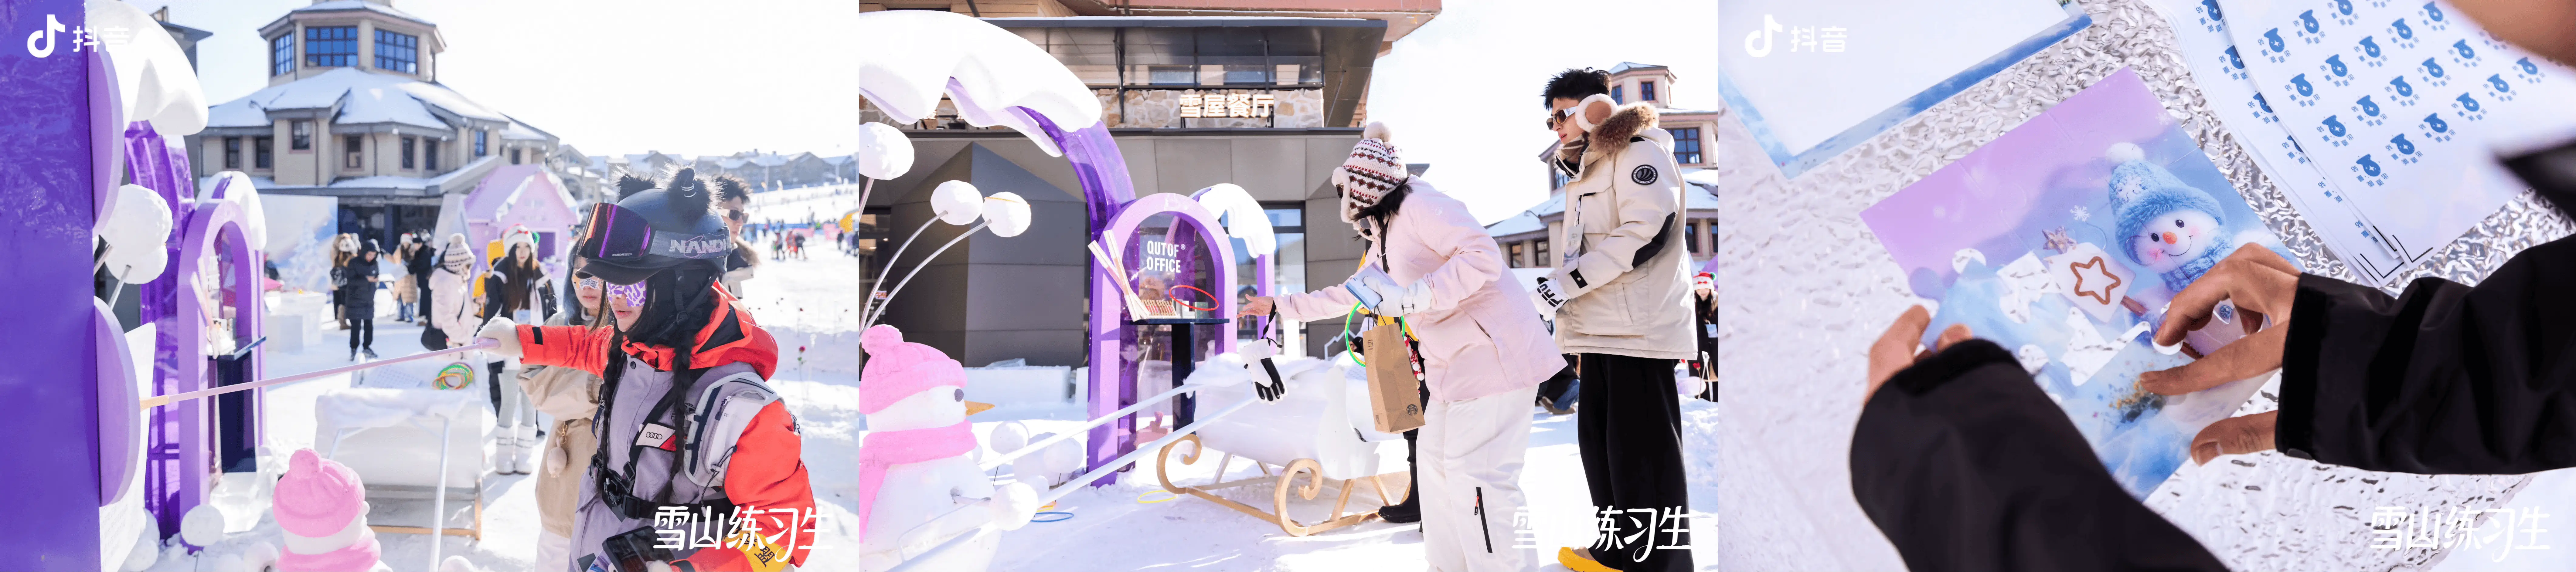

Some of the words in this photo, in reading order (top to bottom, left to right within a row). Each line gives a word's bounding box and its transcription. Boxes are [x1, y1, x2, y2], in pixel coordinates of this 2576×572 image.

[1179, 93, 1274, 118] 雪屋餐厅
[1147, 256, 1181, 273] OFFICE
